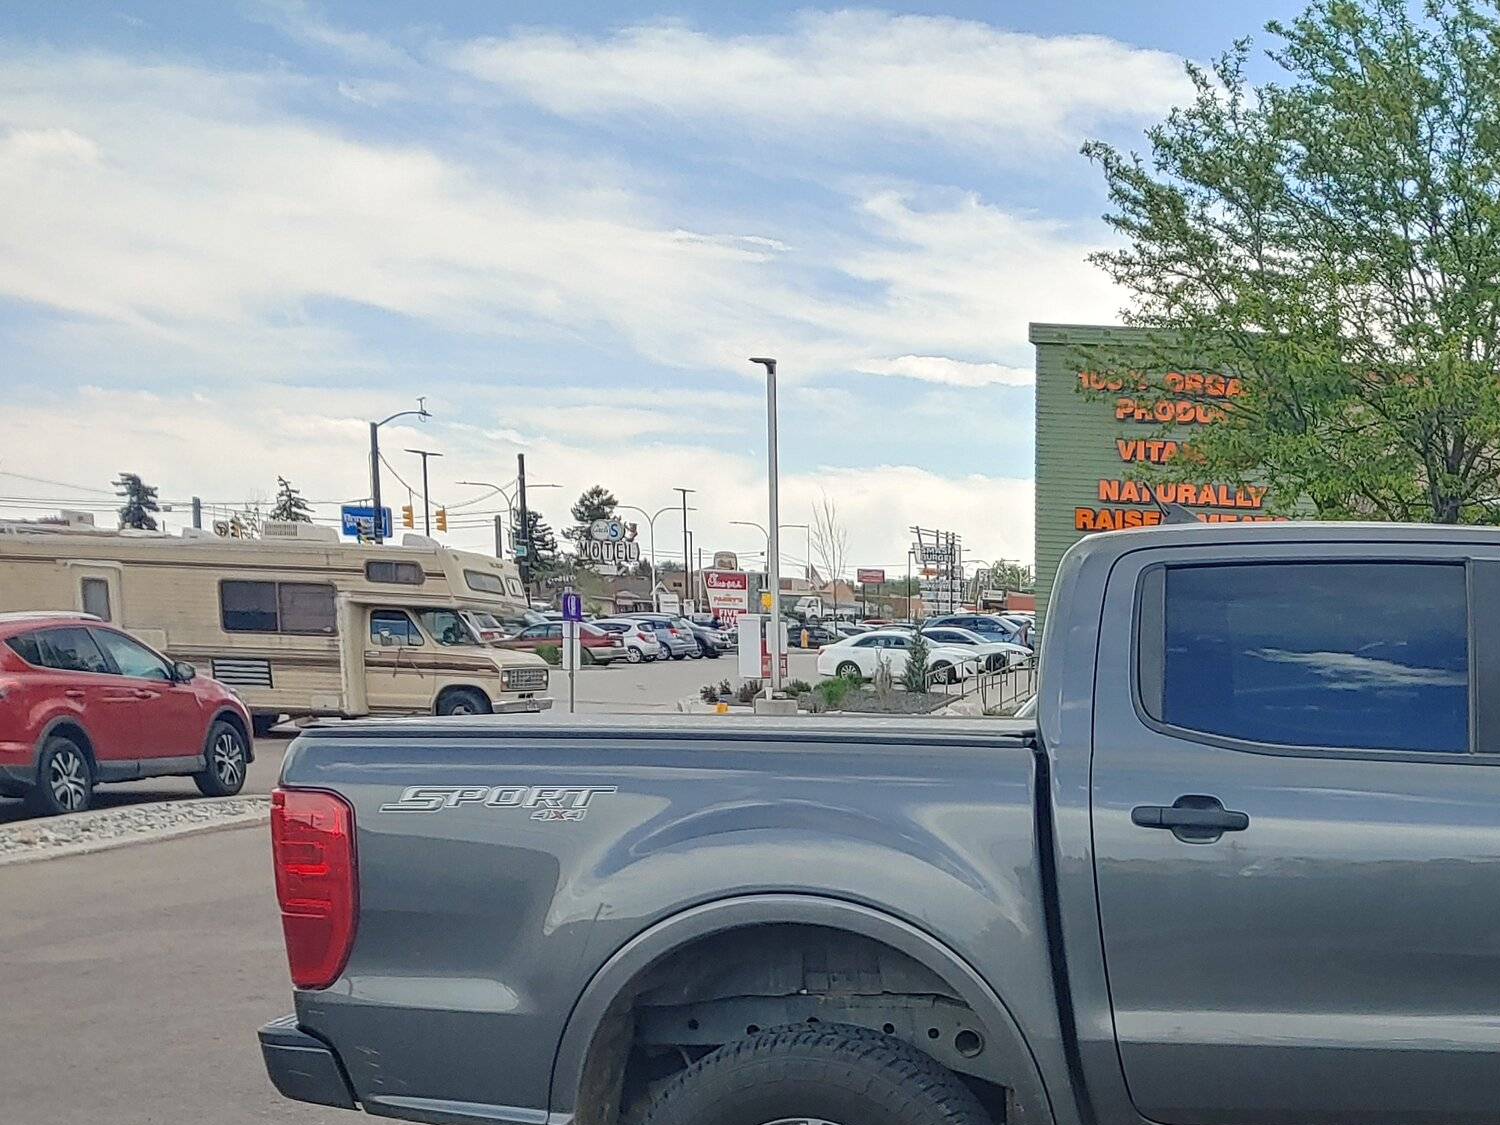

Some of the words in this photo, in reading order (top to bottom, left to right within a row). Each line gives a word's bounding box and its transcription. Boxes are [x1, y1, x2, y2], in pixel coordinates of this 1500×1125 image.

[1163, 371, 1250, 397] ORGA
[1099, 479, 1268, 509] NATURALLY
[1075, 507, 1162, 530] RAISE
[580, 541, 637, 560] MOTEL
[378, 785, 618, 813] SPORT
